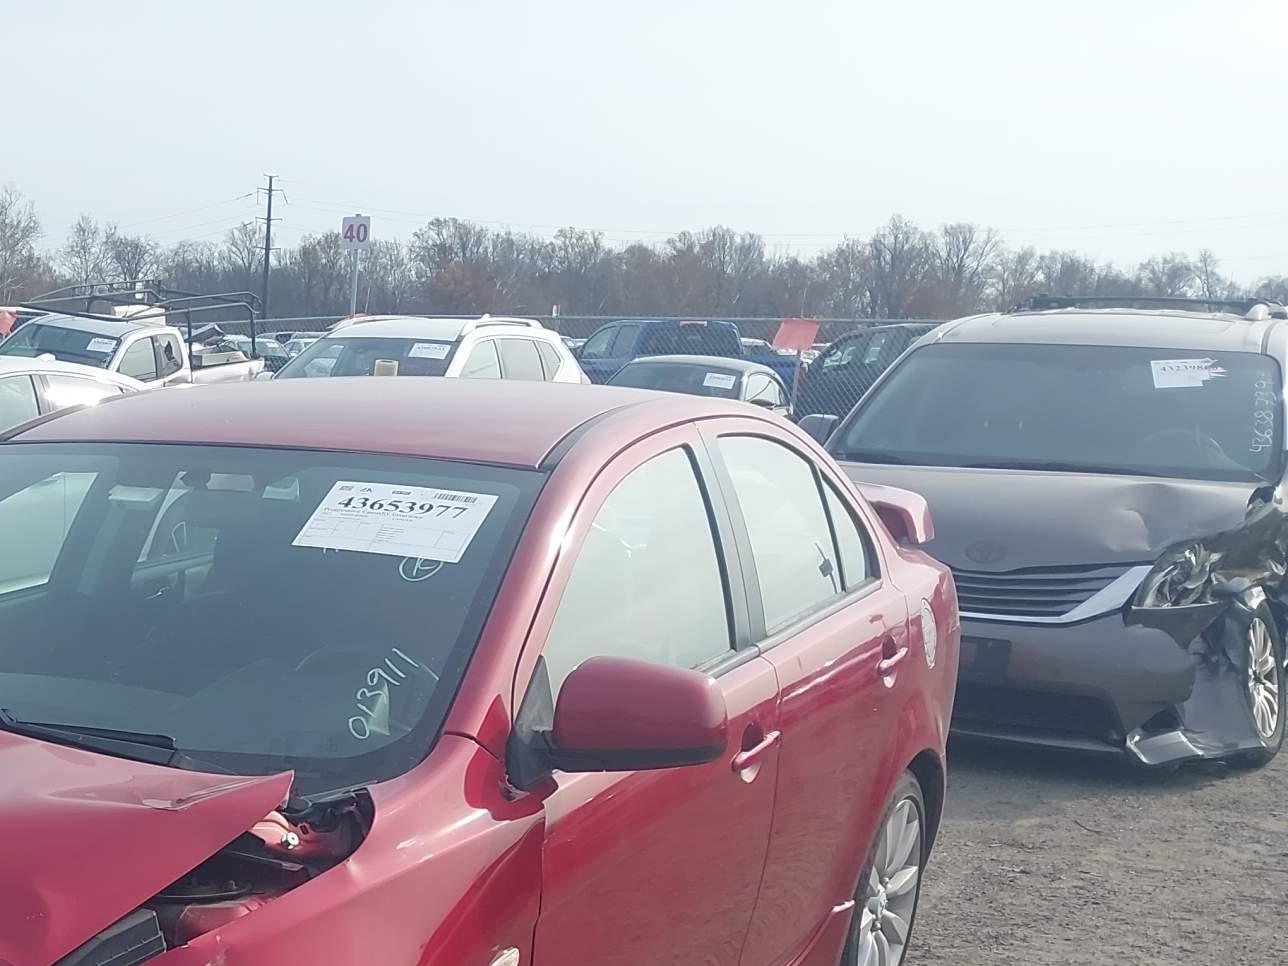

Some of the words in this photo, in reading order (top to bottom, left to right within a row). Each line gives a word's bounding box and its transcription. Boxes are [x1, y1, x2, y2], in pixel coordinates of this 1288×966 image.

[344, 223, 368, 242] 40
[338, 496, 469, 519] 43653977
[348, 648, 420, 740] 013911
